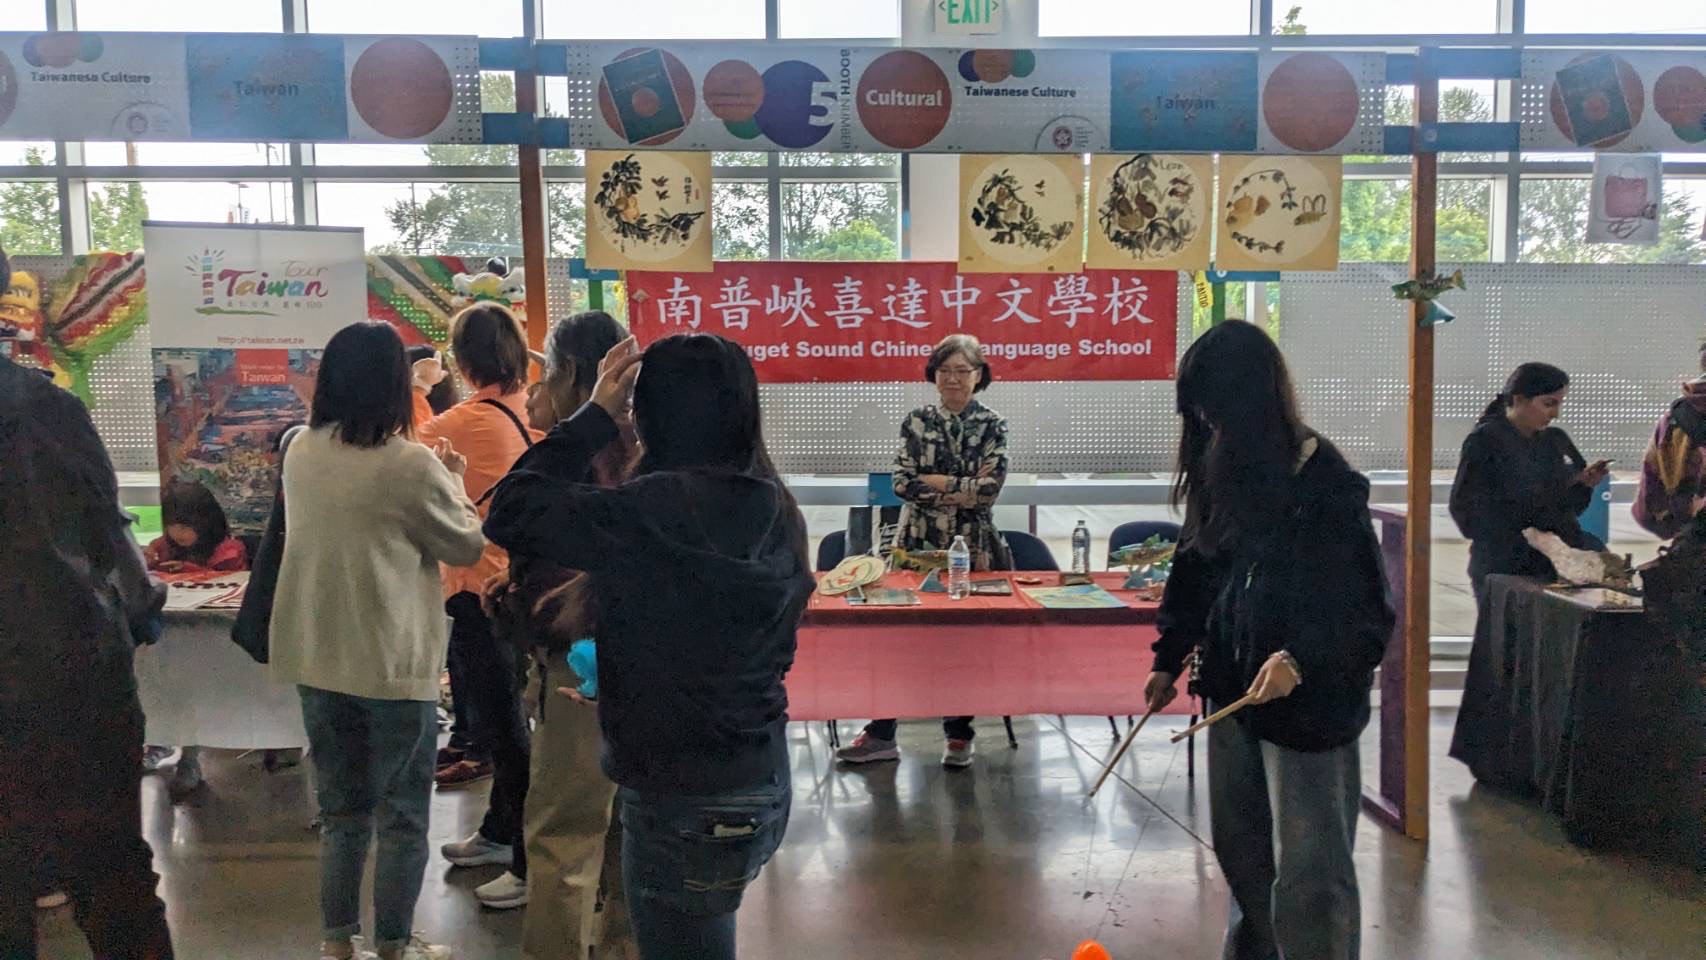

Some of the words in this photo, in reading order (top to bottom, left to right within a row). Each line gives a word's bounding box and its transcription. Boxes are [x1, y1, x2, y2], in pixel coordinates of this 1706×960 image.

[947, 0, 990, 24] EXIT
[31, 71, 98, 82] Taiwanese
[101, 72, 151, 83] Culture
[840, 49, 850, 95] BOOTH
[233, 80, 299, 96] Taiwan
[865, 89, 943, 106] Cultural
[964, 85, 1029, 97] Taiwanese
[1031, 86, 1077, 98] Culture
[808, 80, 840, 127] 5
[1156, 94, 1215, 109] Taiwan
[218, 268, 328, 297] Taiwan
[657, 274, 1154, 331] 南普峽喜達中文學校
[742, 341, 790, 362] uget
[796, 340, 864, 357] Sound
[982, 342, 1071, 359] anguage
[1079, 338, 1152, 355] School
